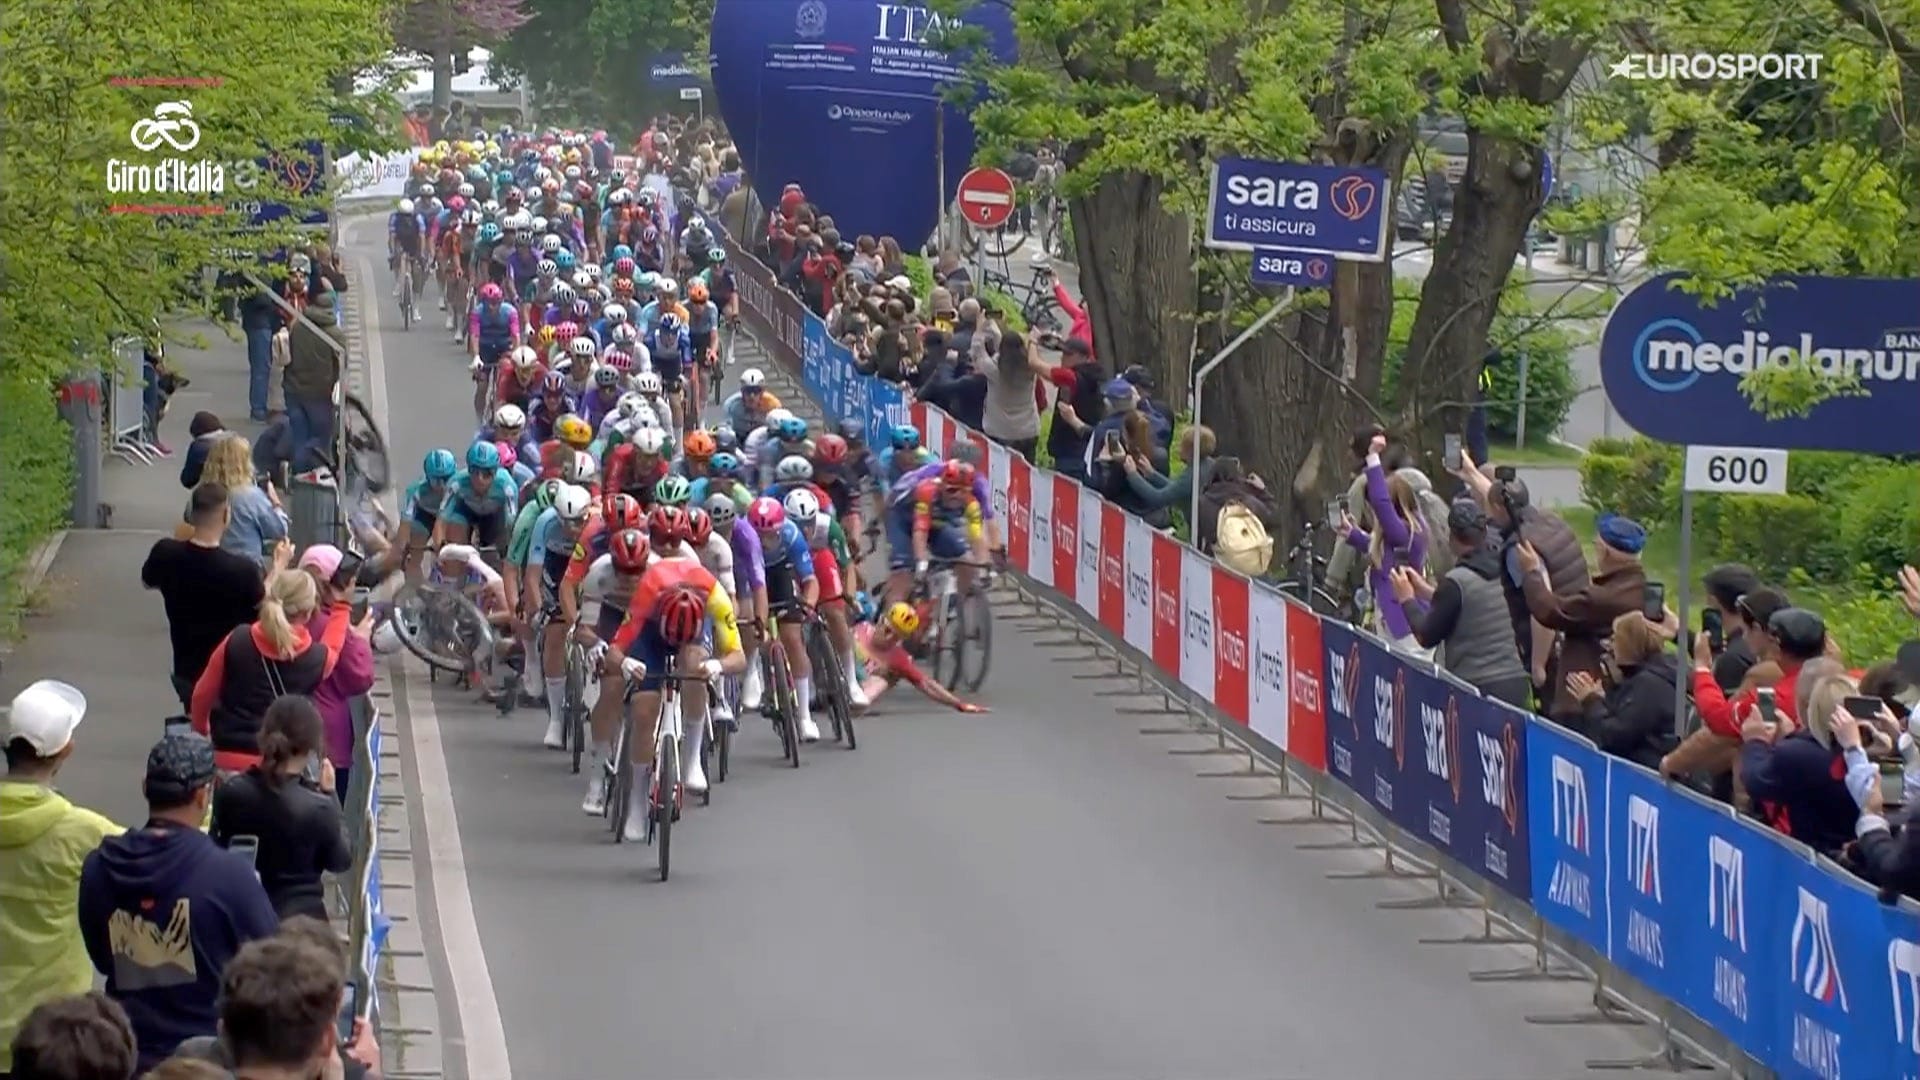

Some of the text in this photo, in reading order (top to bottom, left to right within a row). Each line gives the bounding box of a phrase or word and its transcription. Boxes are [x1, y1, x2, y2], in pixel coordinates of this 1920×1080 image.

[1226, 174, 1320, 210] sara
[1224, 213, 1317, 237] ti assicura
[1259, 255, 1302, 275] sara
[1885, 333, 1920, 349] BAN
[1708, 456, 1768, 485] 600
